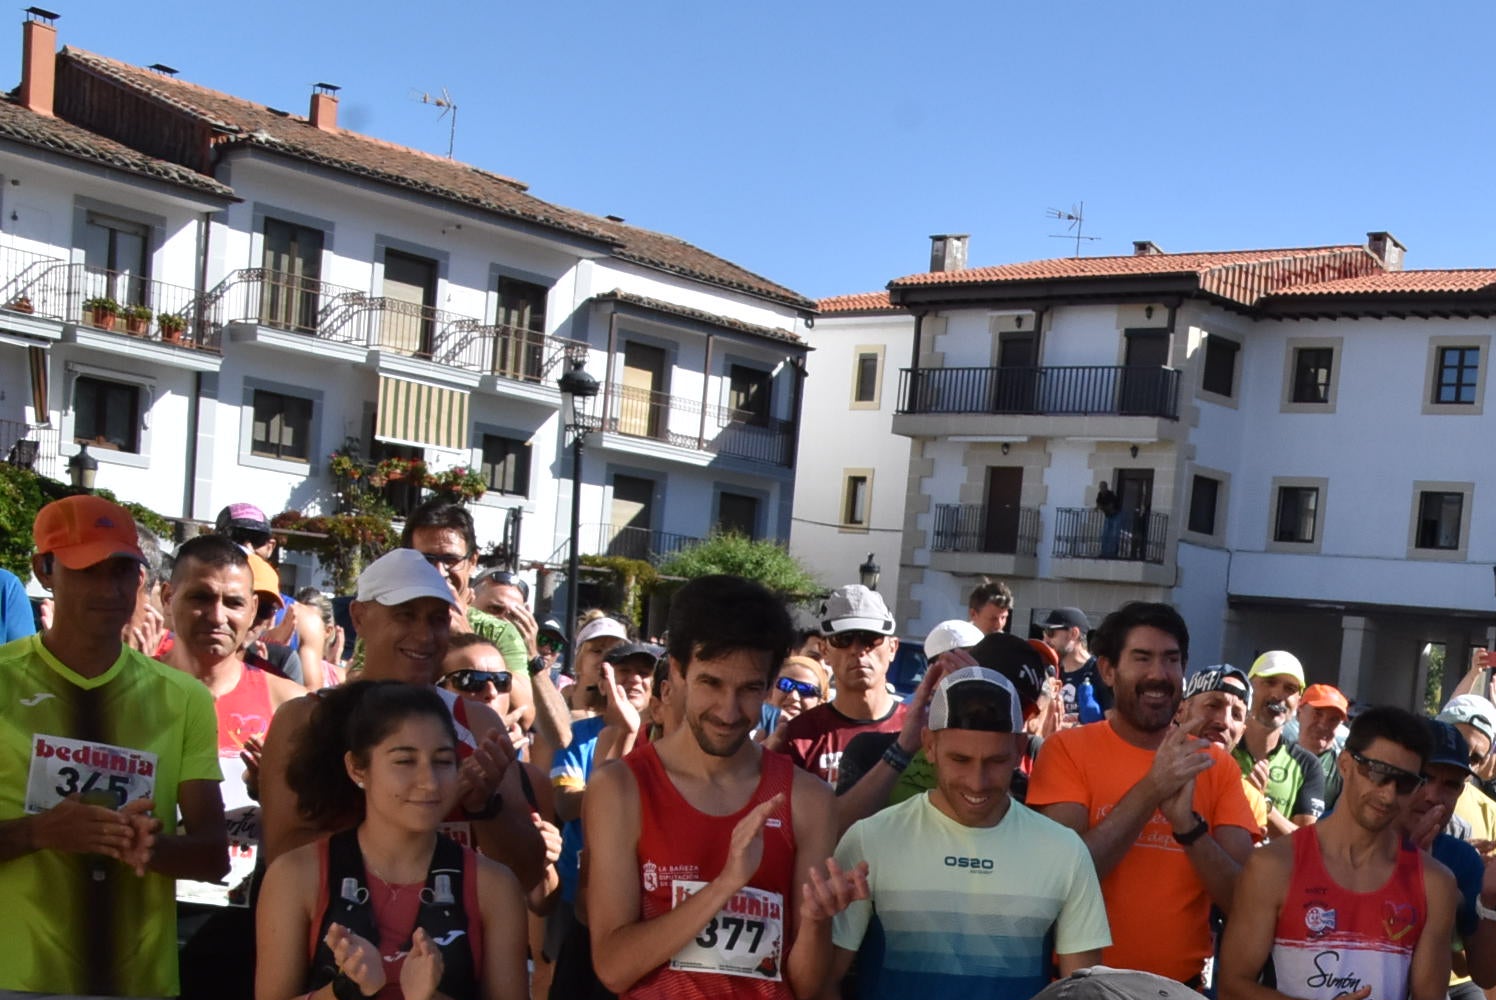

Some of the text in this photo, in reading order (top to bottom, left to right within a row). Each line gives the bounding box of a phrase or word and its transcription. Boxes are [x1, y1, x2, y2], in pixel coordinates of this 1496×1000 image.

[35, 739, 154, 777] bedunia
[676, 886, 780, 920] bunia
[696, 916, 765, 954] 377
